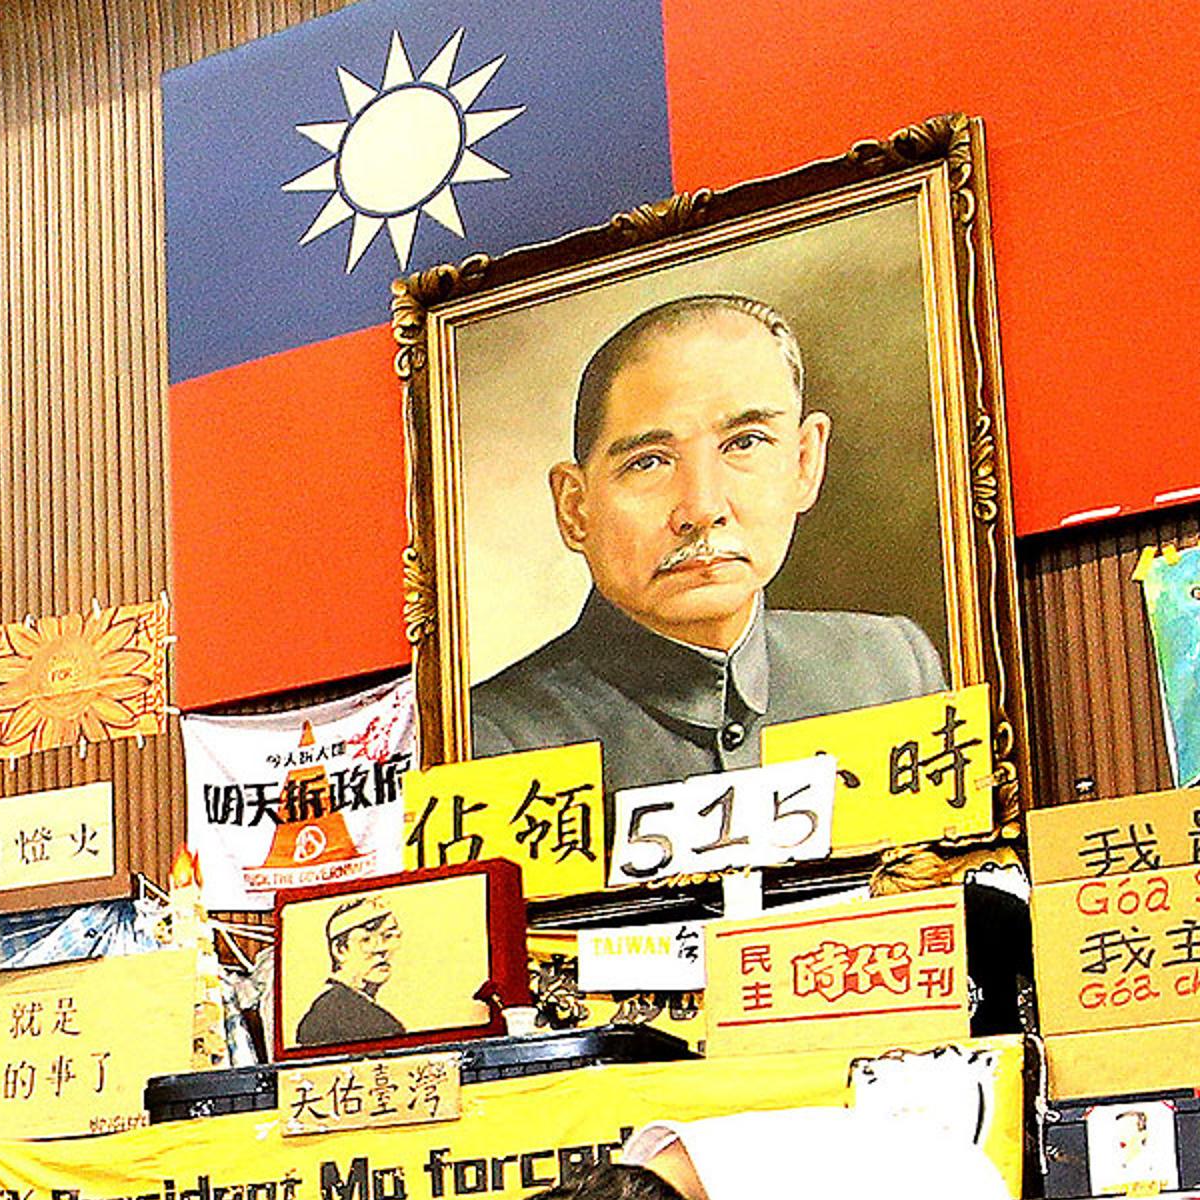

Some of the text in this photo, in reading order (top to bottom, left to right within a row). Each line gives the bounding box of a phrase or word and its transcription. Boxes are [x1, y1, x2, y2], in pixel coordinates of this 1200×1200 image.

[406, 779, 598, 869] 佔領
[620, 782, 820, 877] 515
[741, 924, 955, 1012] 民主 時代 周刊
[290, 1060, 449, 1119] 天佑臺灣
